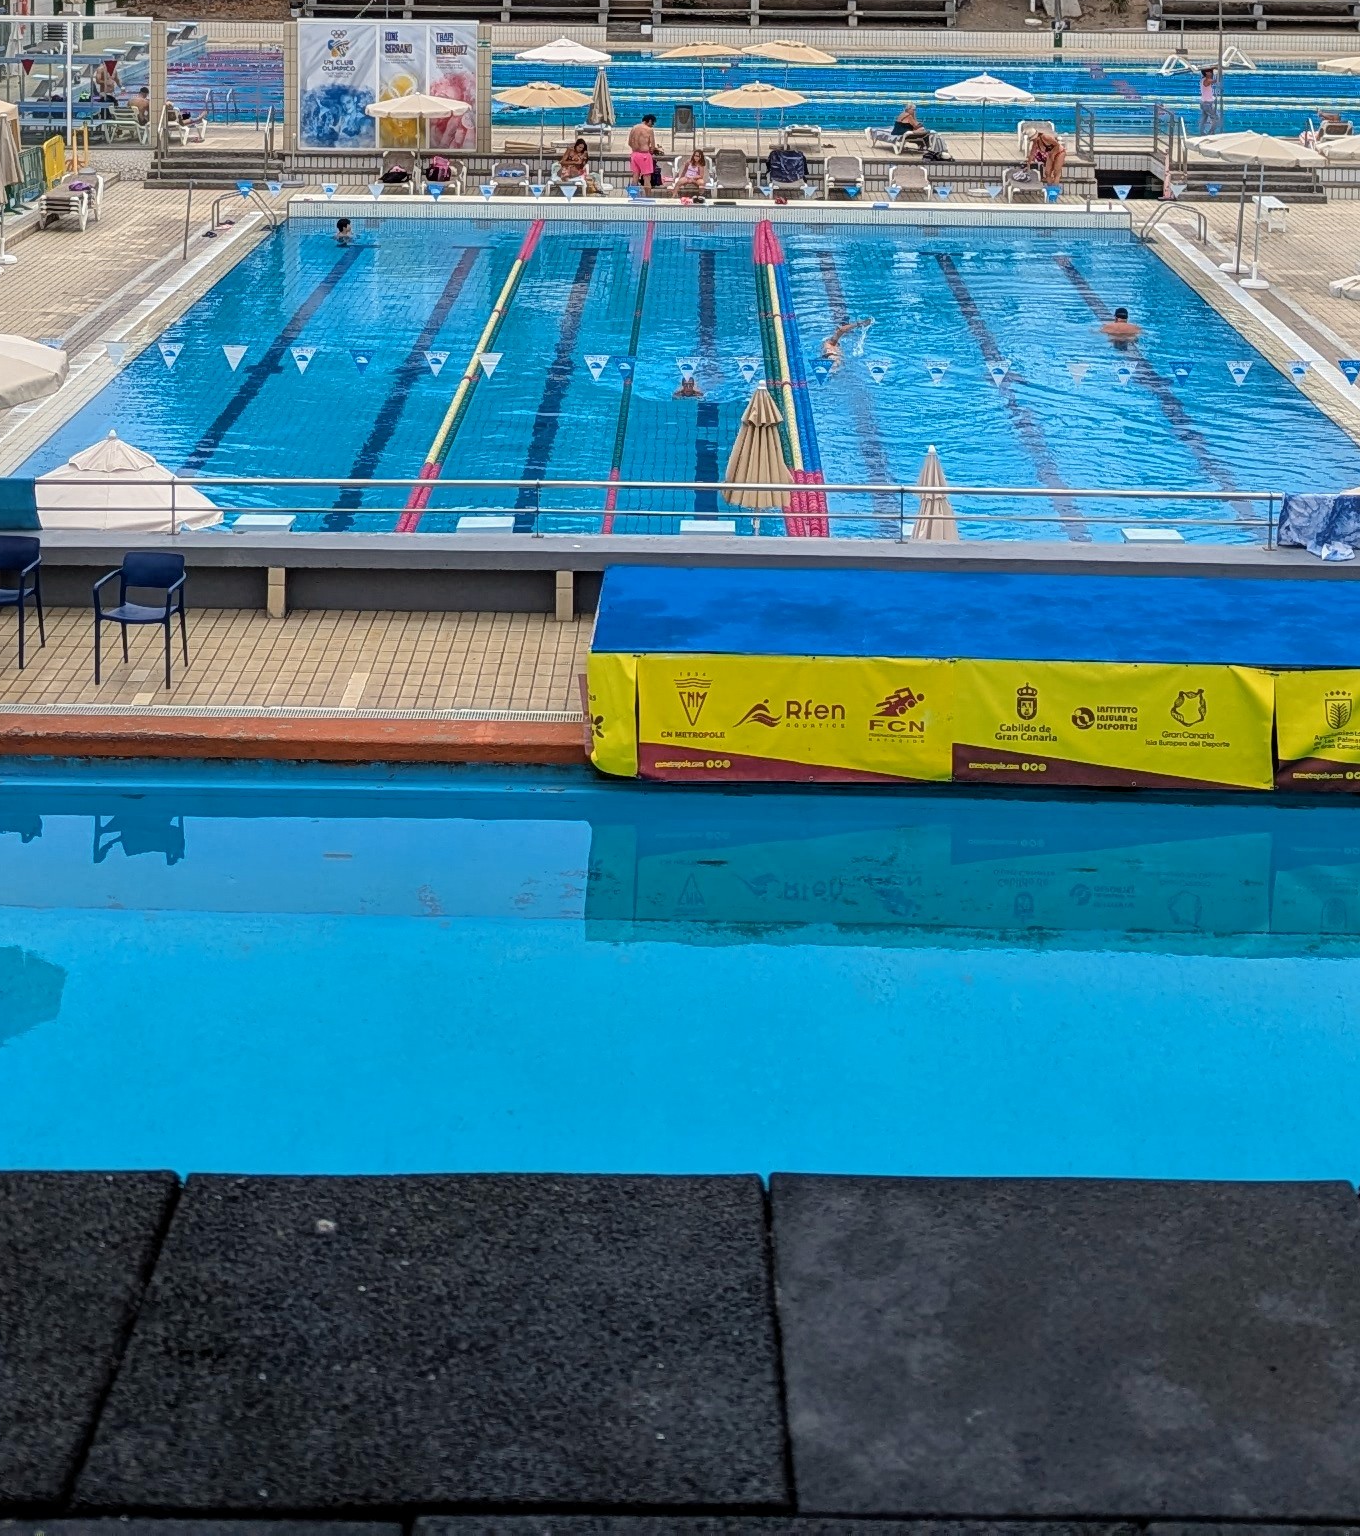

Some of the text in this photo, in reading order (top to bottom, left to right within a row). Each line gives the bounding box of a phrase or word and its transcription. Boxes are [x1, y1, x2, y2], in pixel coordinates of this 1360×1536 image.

[786, 699, 846, 720] Rfen
[1096, 706, 1138, 714] INSTITUTO
[869, 720, 925, 732] FCN
[1000, 724, 1052, 733] Cabildo de
[674, 731, 726, 739] METROPOLE
[994, 732, 1058, 742] Gran Canaria
[1202, 740, 1230, 748] Deporte
